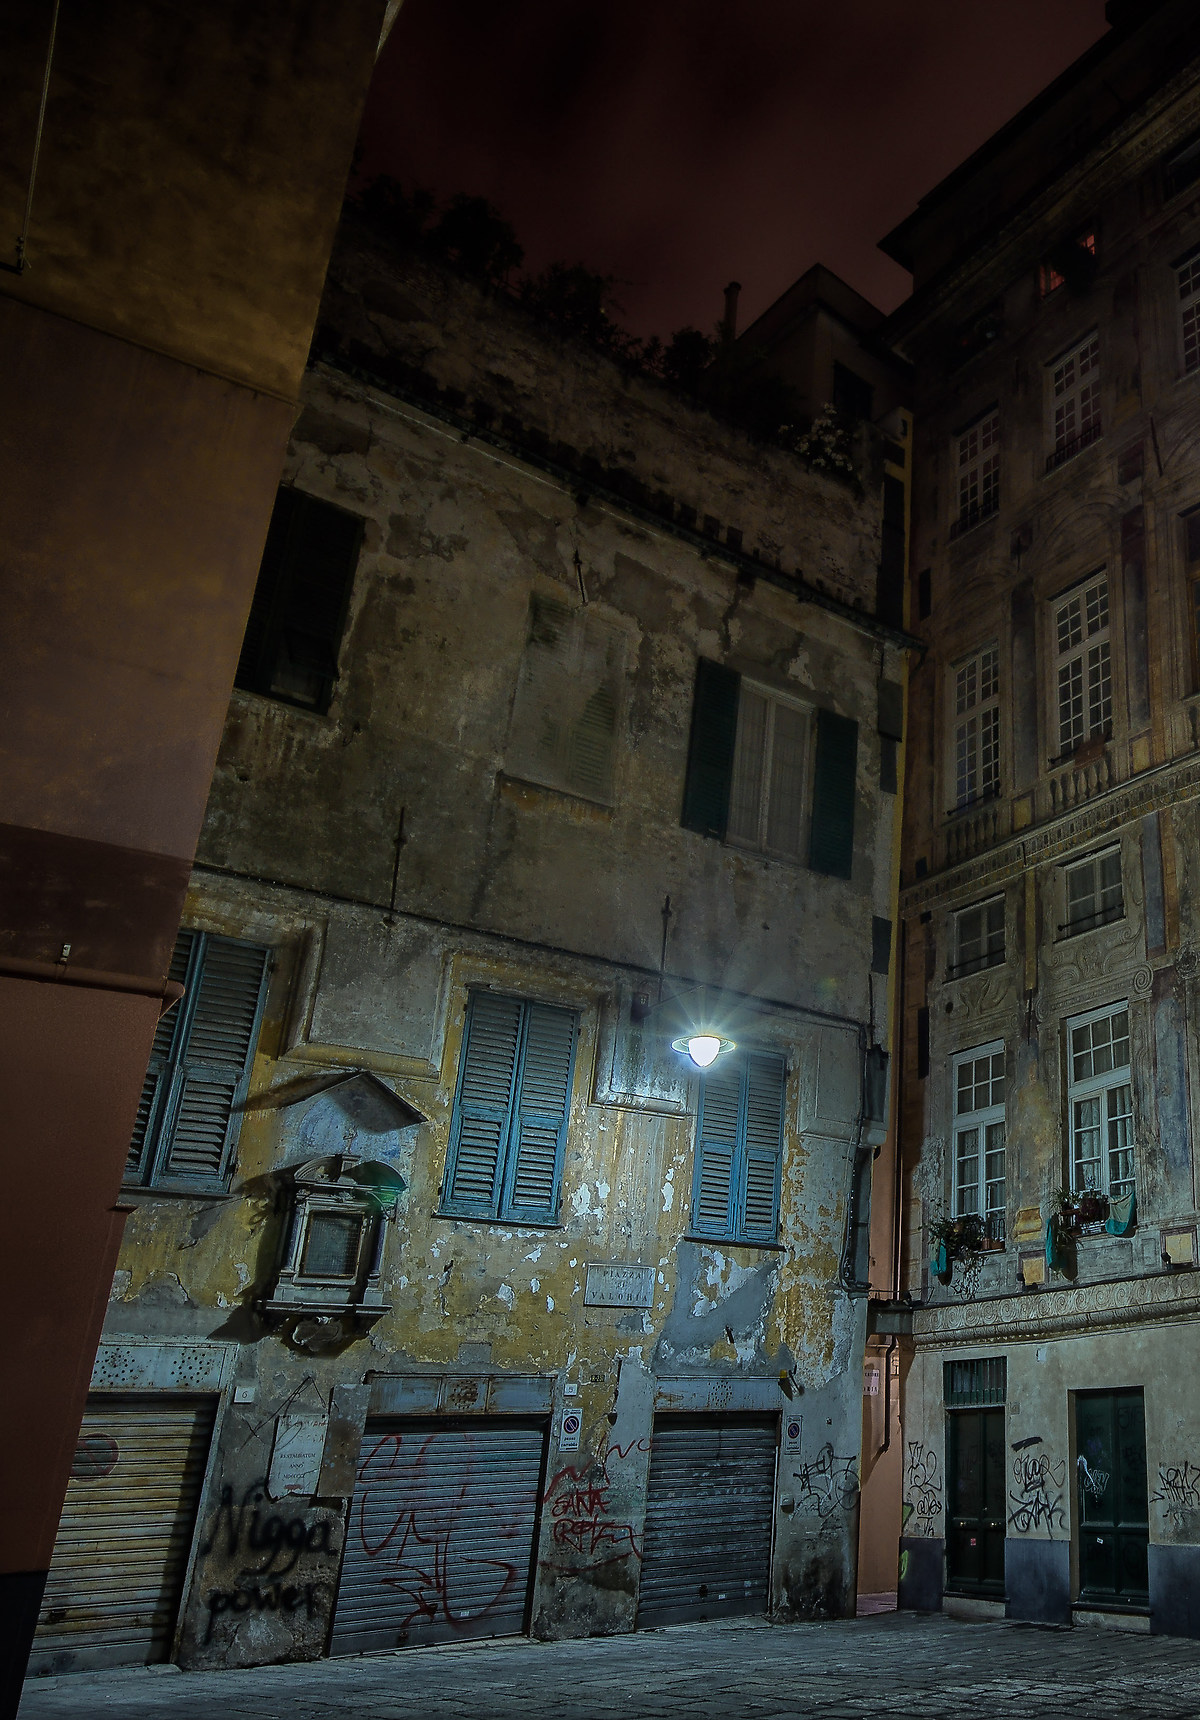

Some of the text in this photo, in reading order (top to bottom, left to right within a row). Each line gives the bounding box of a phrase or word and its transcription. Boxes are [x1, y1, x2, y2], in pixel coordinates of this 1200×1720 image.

[603, 1270, 641, 1279] PIAZZA
[592, 1292, 648, 1302] VALORIA
[242, 1390, 248, 1399] 6
[200, 1478, 338, 1577] Nigga
[207, 1583, 330, 1645] power
